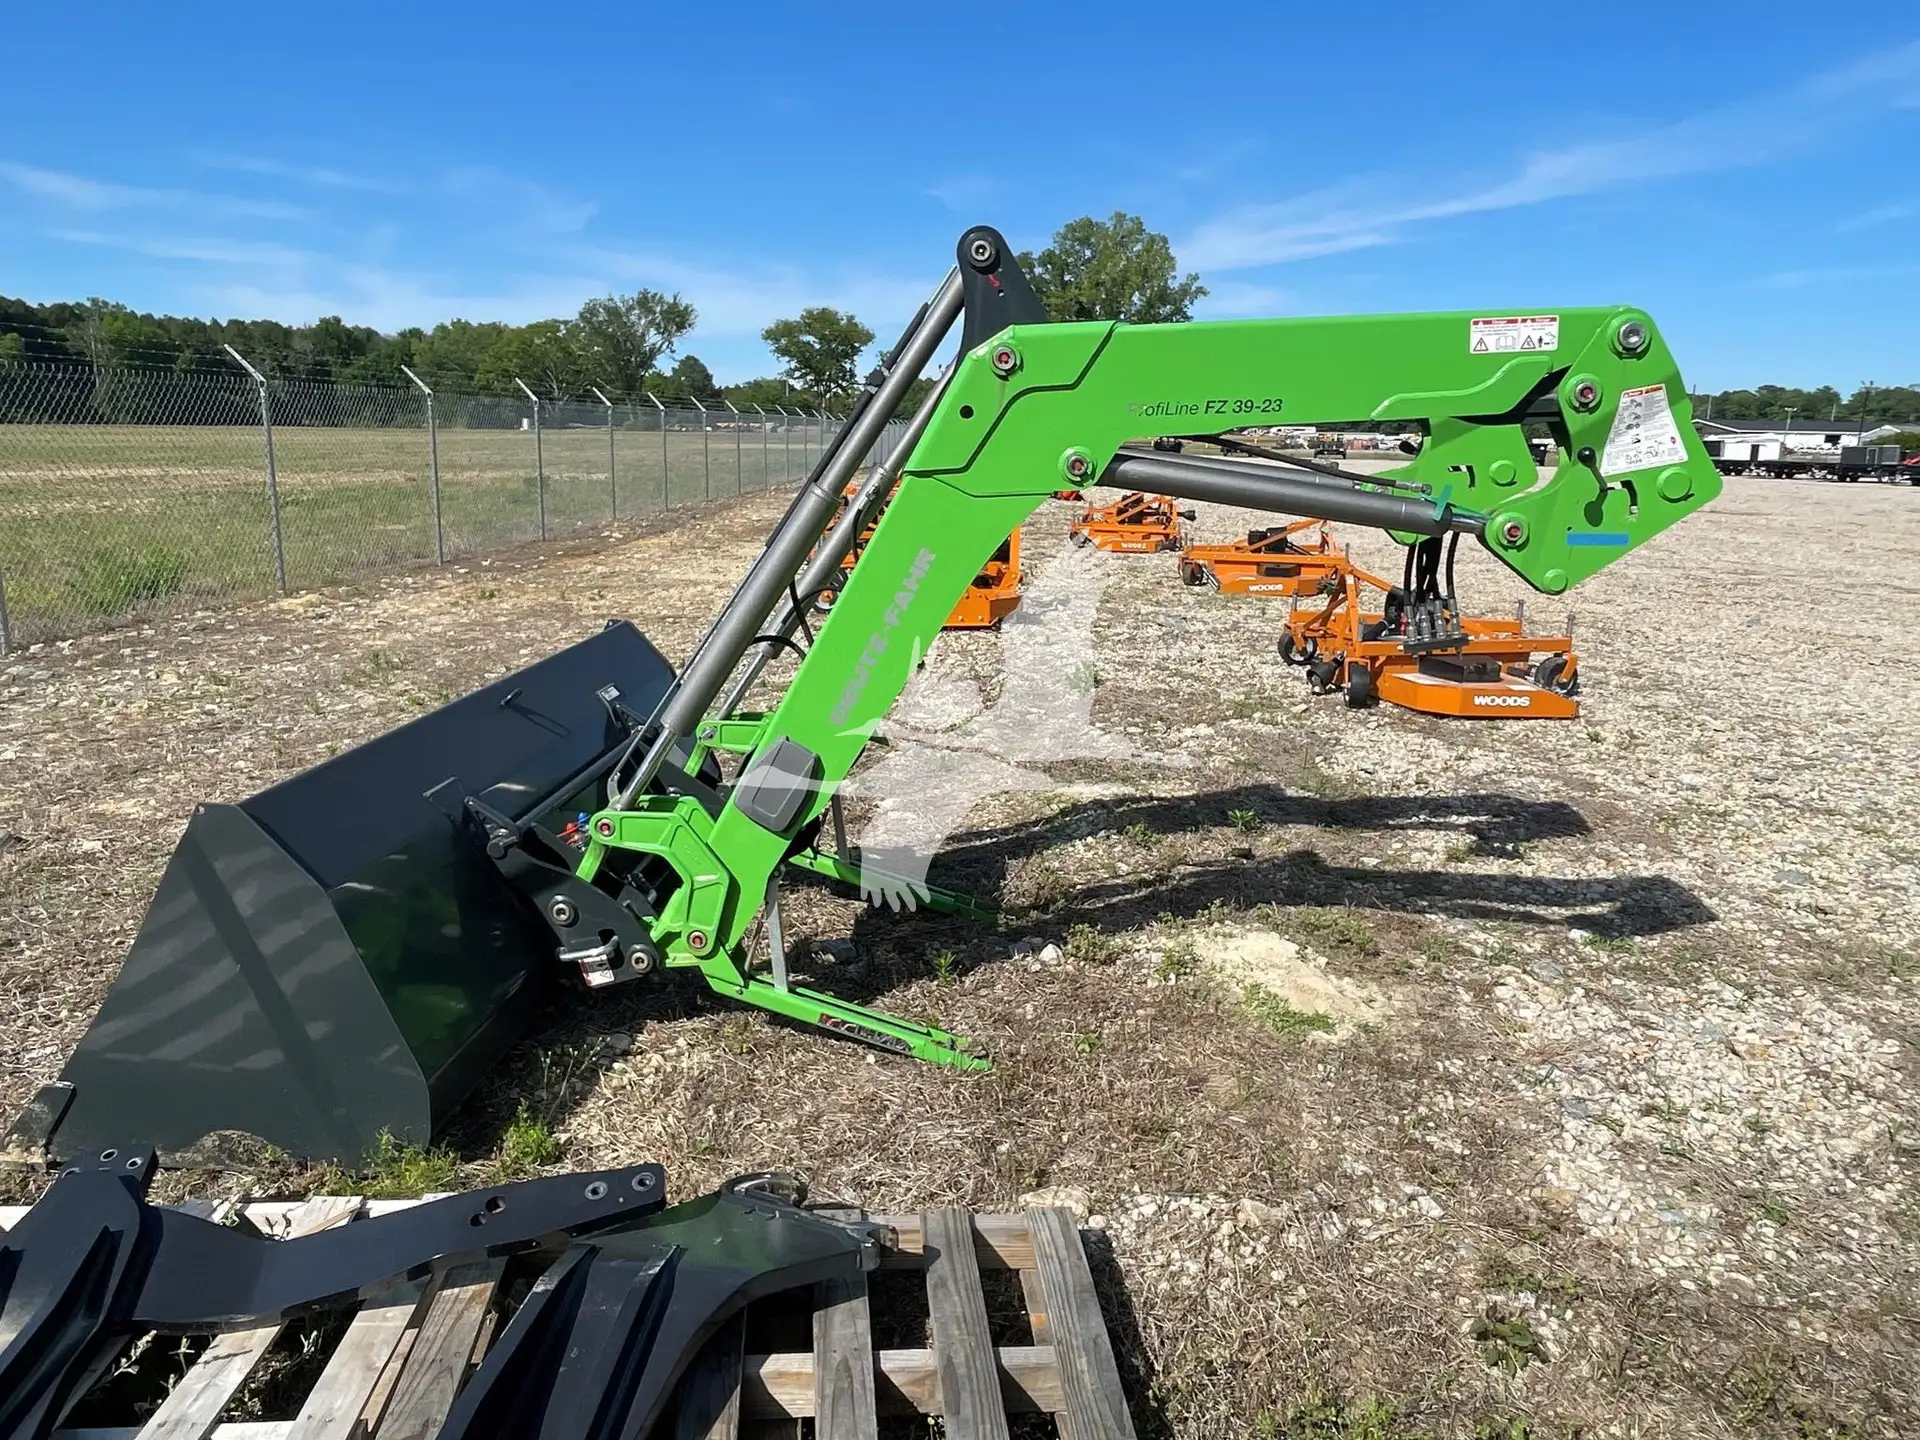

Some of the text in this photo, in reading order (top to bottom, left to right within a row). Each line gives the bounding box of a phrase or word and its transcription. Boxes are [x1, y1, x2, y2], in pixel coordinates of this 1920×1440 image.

[1204, 399, 1229, 414] FZ
[1232, 398, 1283, 414] 39-23
[1248, 583, 1283, 592] WOODS
[1474, 695, 1531, 707] WOODS
